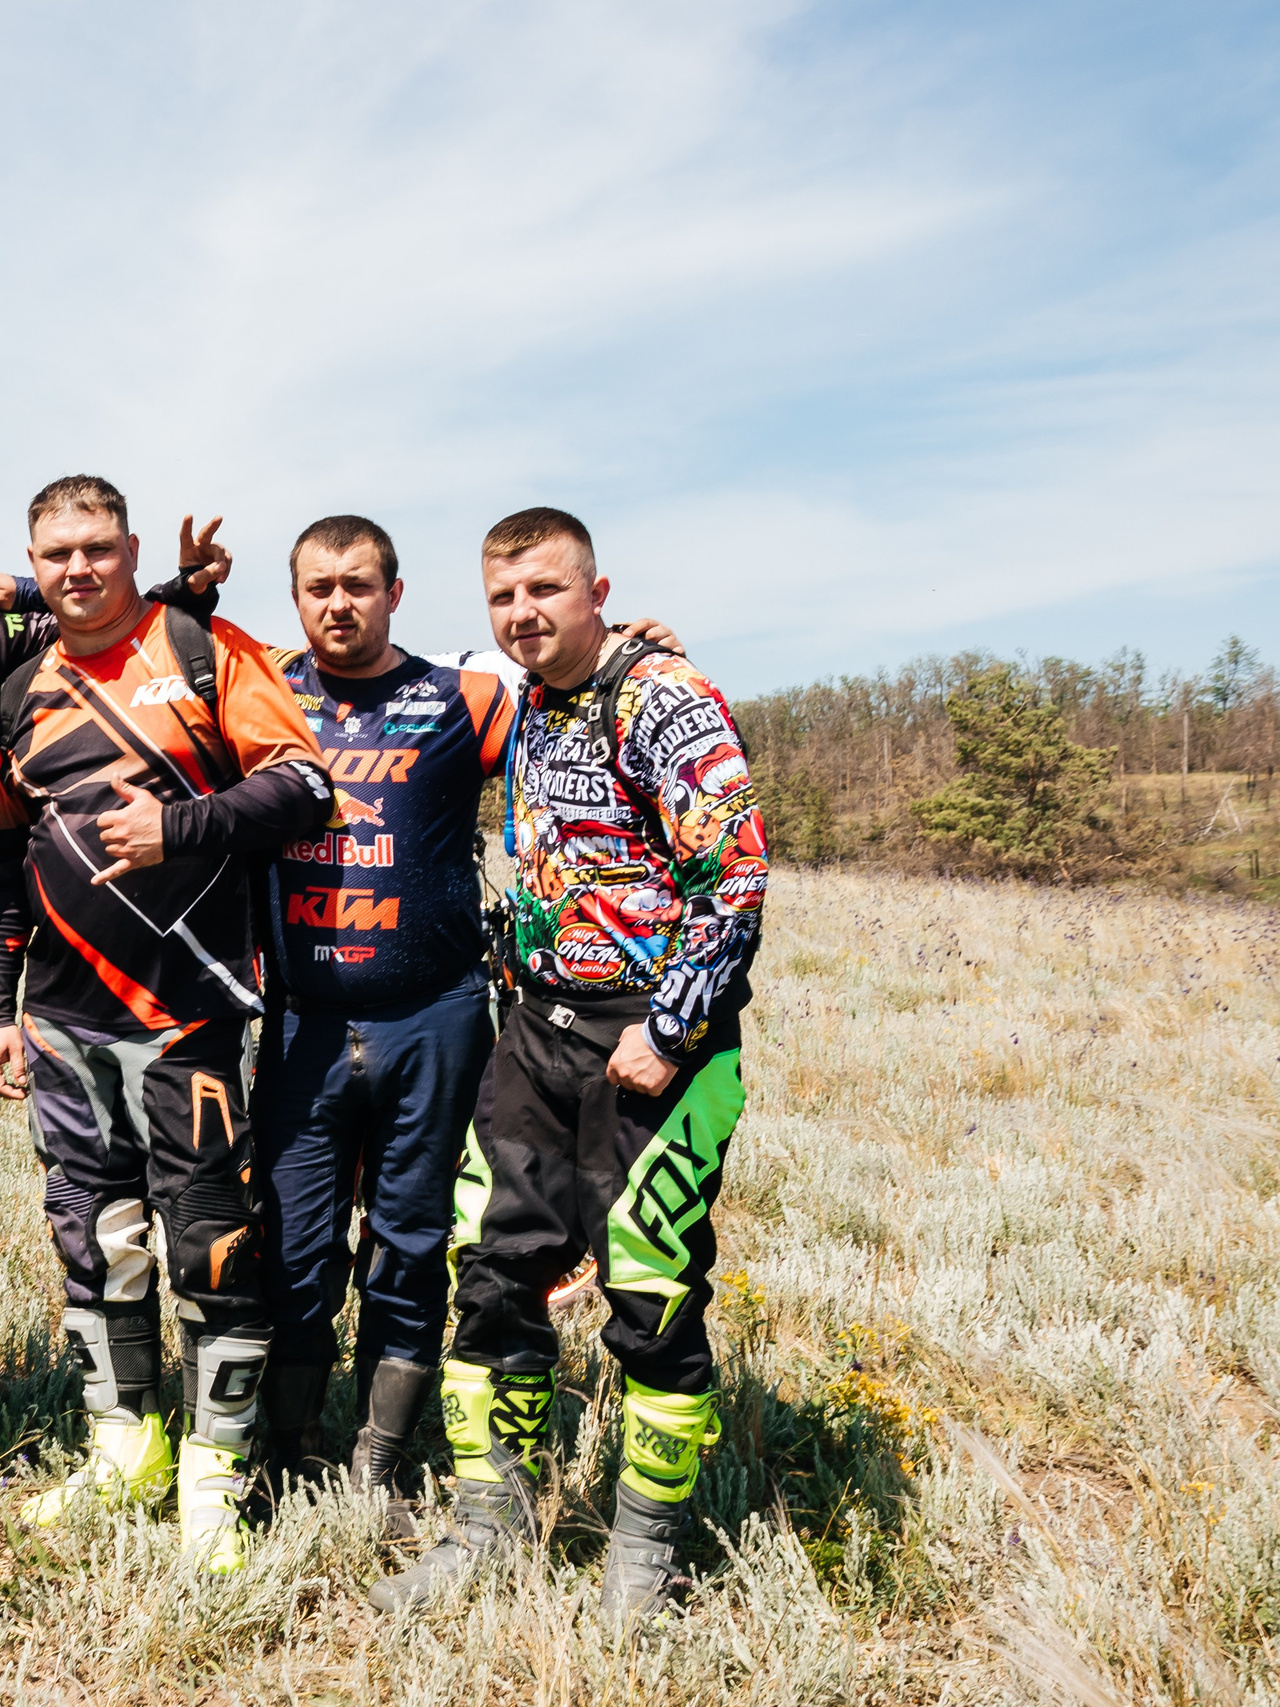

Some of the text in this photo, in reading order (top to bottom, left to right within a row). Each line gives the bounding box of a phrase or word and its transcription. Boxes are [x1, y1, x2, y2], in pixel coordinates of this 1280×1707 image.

[282, 832, 394, 867] Red Bull
[715, 873, 768, 896] O'NEA
[286, 886, 400, 930] KTM
[572, 929, 600, 942] High
[557, 940, 622, 964] O'NEAL
[628, 1112, 709, 1261] FOX
